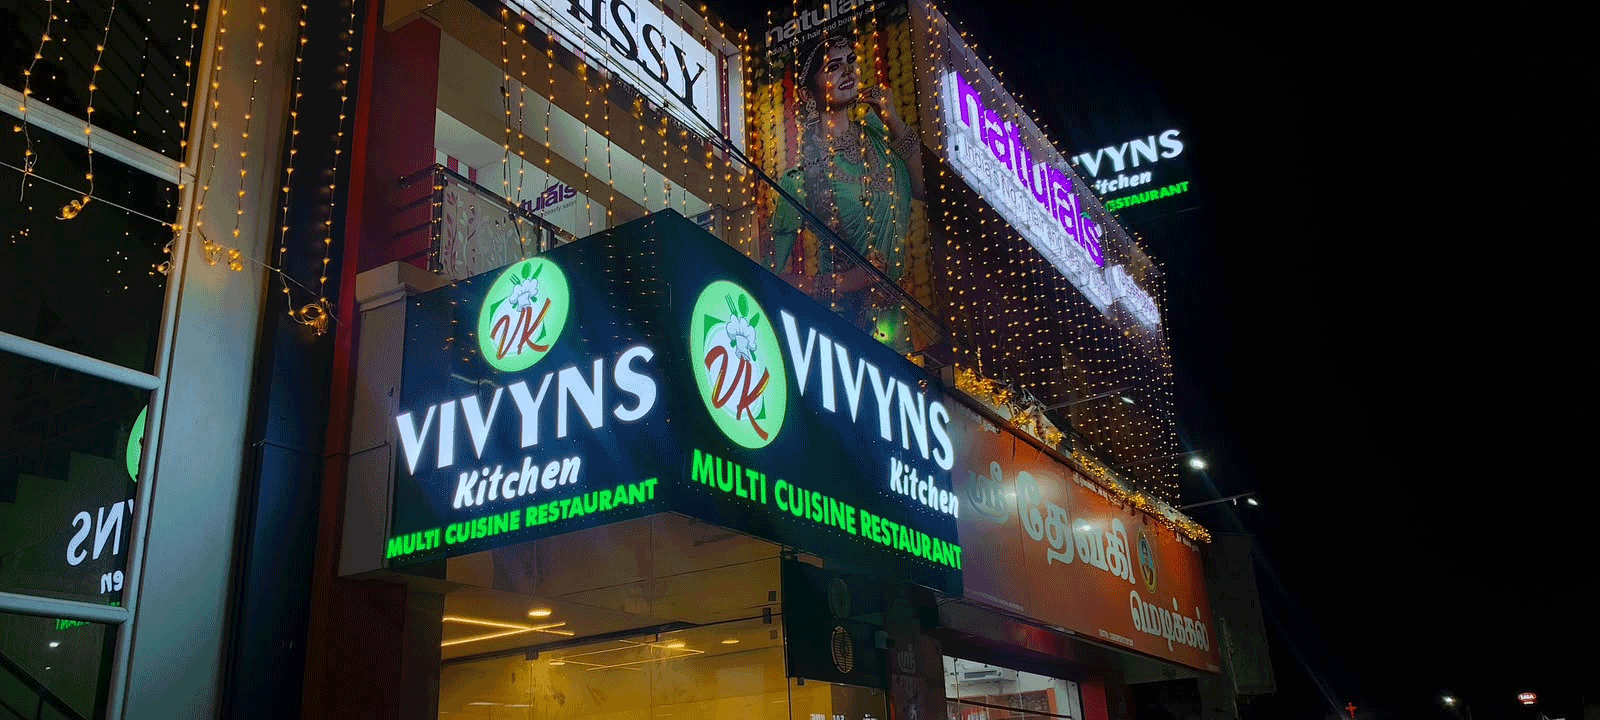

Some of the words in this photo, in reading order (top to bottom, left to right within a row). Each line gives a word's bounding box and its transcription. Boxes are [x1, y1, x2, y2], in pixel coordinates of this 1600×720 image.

[838, 10, 863, 27] beaty
[957, 70, 1105, 268] naturals
[1094, 171, 1152, 195] itchen
[396, 346, 657, 476] VIVYNS
[781, 309, 955, 471] VIVYNS
[386, 528, 440, 559] MULTI
[445, 510, 521, 545] CUISINE
[526, 478, 658, 528] RESTAURANT
[453, 456, 581, 509] Kitchen
[692, 448, 767, 504] MULTI
[774, 479, 857, 535] CUISINE
[860, 509, 962, 570] RESTAURANT
[890, 456, 959, 518] Kitchen
